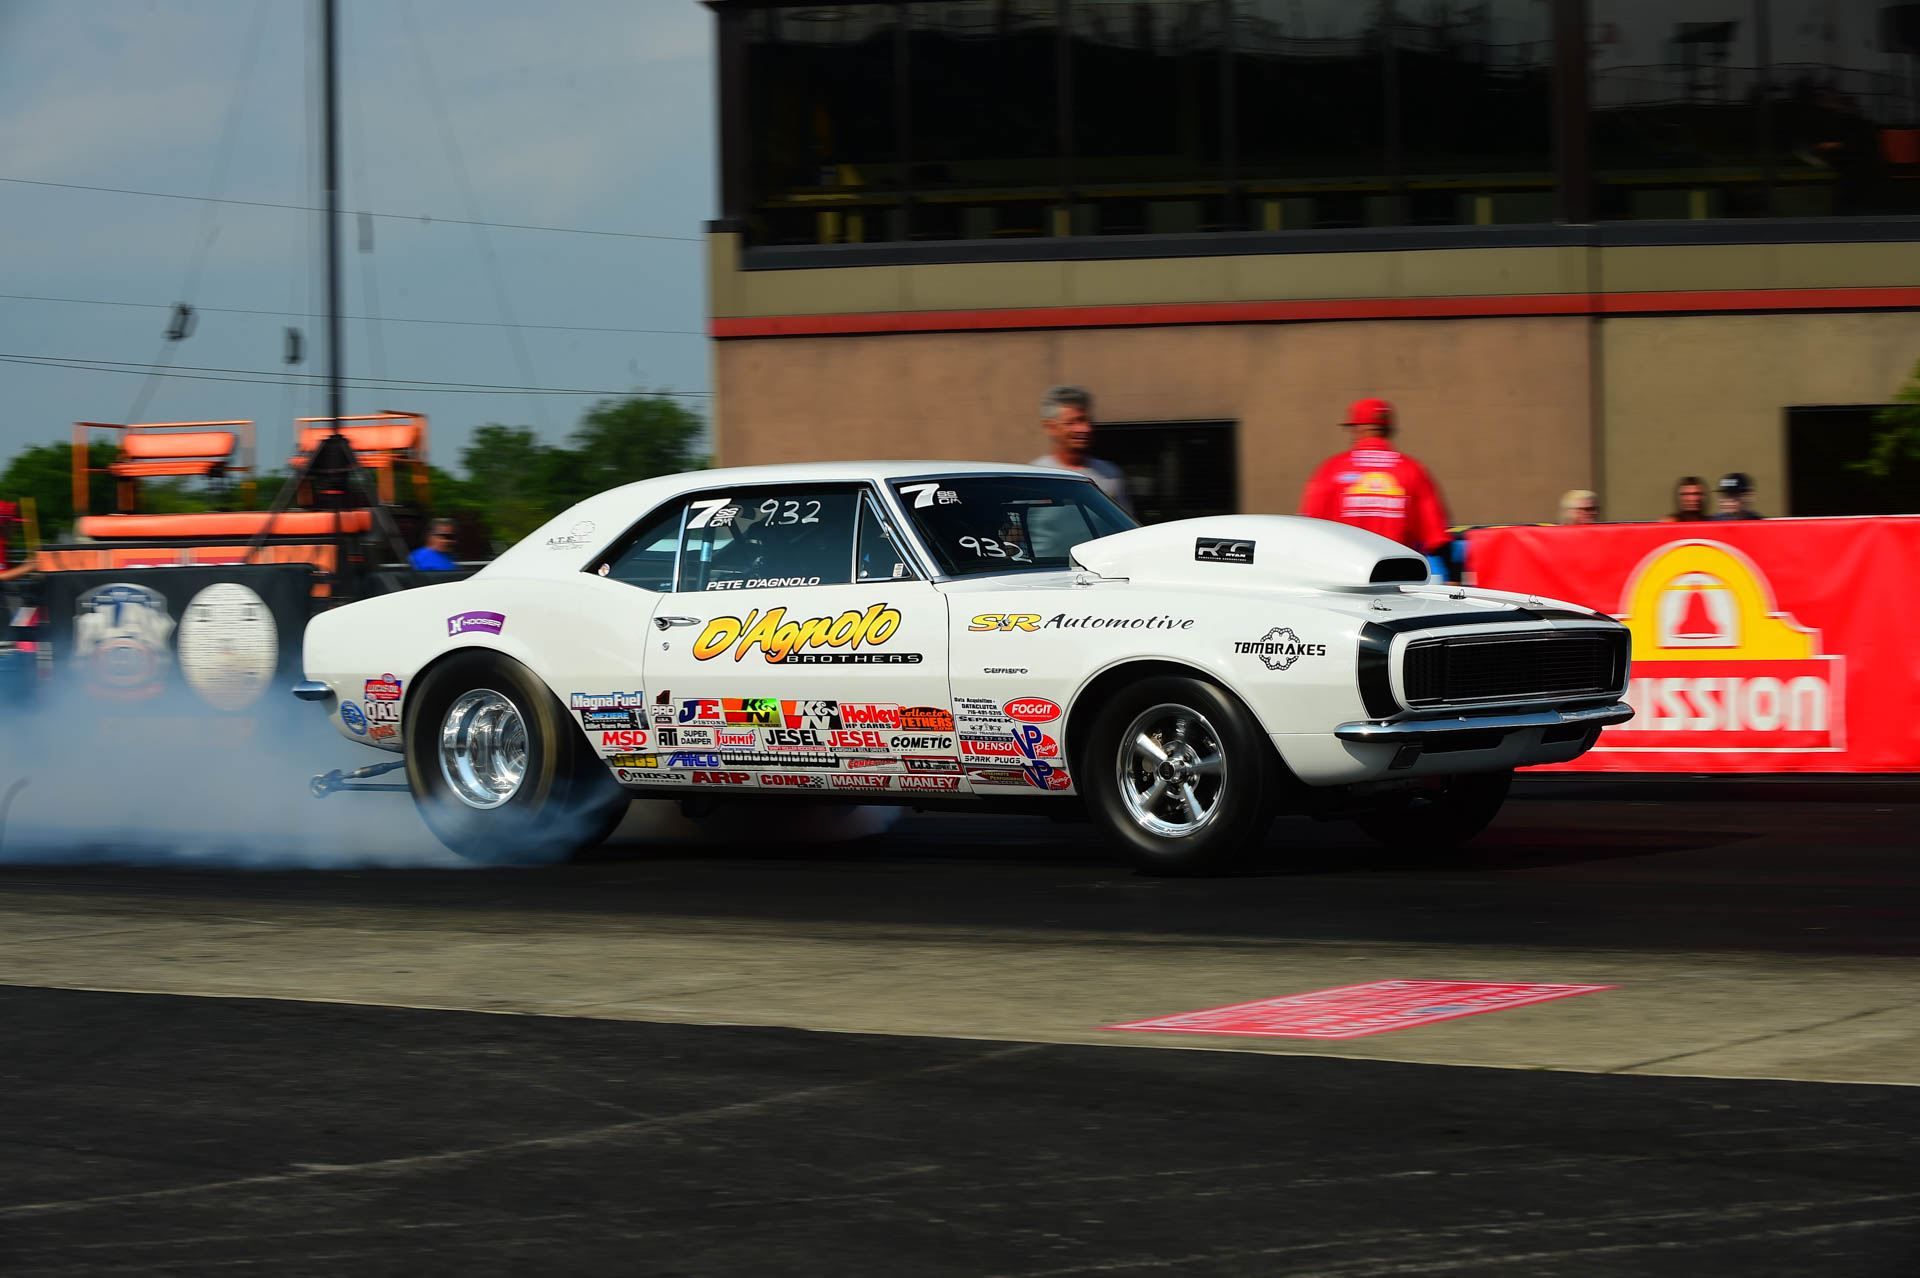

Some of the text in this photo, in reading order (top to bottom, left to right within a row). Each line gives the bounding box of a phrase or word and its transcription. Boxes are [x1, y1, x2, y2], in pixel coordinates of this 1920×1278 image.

[900, 483, 940, 508] 7
[686, 498, 732, 529] 7
[706, 576, 820, 591] PETE D'AGNOLO
[1044, 612, 1195, 632] Automotive
[692, 602, 902, 663] D'Agnolo
[786, 655, 920, 663] BROTHERS
[571, 692, 643, 711] MagnaFuel
[1011, 704, 1053, 714] FOGGIT
[364, 701, 400, 726] QA1
[651, 705, 676, 716] PRO
[841, 705, 900, 728] Holley
[901, 717, 953, 727] TETHERS
[602, 731, 647, 746] MSD
[658, 728, 679, 746] ATI
[765, 729, 821, 746] JESEL
[827, 731, 884, 747] JESEL
[890, 734, 953, 749] COMETIC
[977, 742, 1013, 751] DENSO
[692, 771, 751, 784] ARP
[760, 774, 811, 785] COMP
[832, 775, 884, 787] MANLEY
[900, 776, 954, 788] MANLEY
